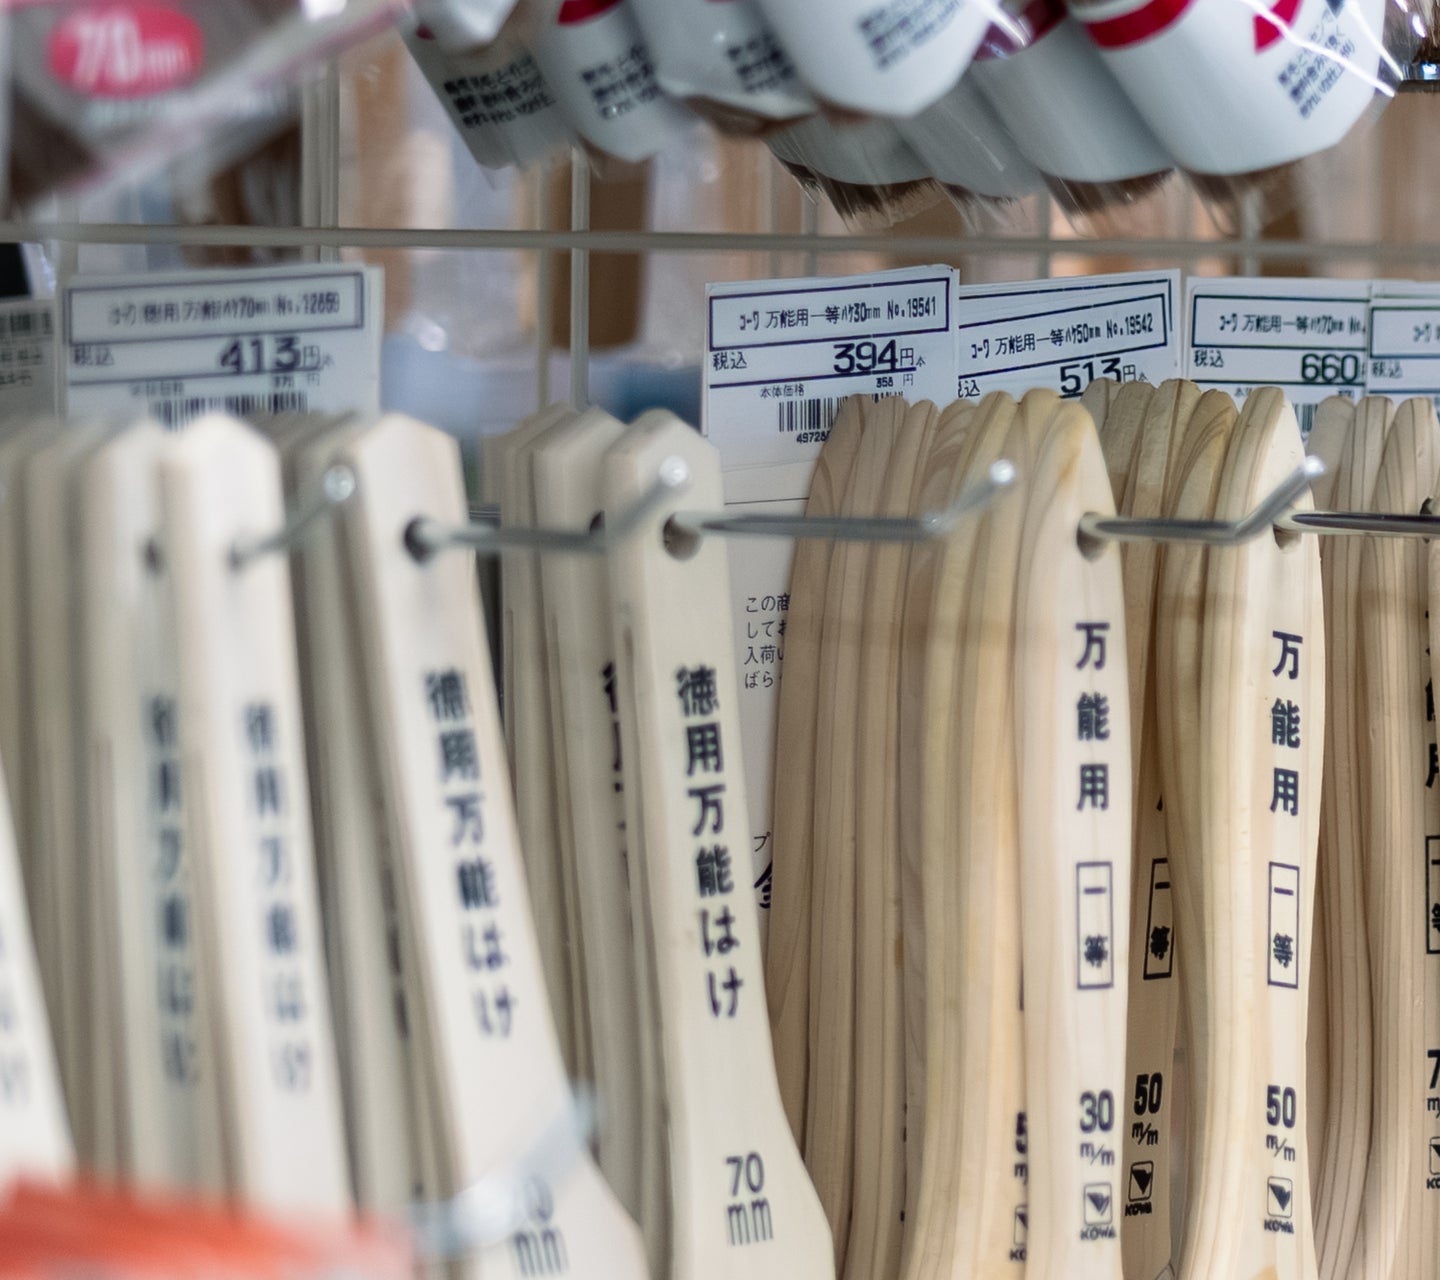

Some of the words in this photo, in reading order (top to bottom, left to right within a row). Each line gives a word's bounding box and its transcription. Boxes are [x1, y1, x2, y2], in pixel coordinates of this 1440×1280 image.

[887, 296, 936, 320] No.19541
[1106, 312, 1153, 339] No.19542
[712, 351, 748, 371] 税込
[1074, 621, 1110, 812] 万能用
[1267, 630, 1303, 818] 万能用
[422, 668, 516, 1040] 徳用万能はけ
[676, 664, 744, 1021] 徳用万能はけ
[1081, 887, 1110, 970] 一等
[1272, 885, 1295, 969] 一等
[1078, 1088, 1116, 1134] 30
[1134, 1073, 1162, 1117] 50
[1265, 1084, 1298, 1130] 50
[725, 1152, 765, 1197] 70
[726, 1197, 774, 1246] mm
